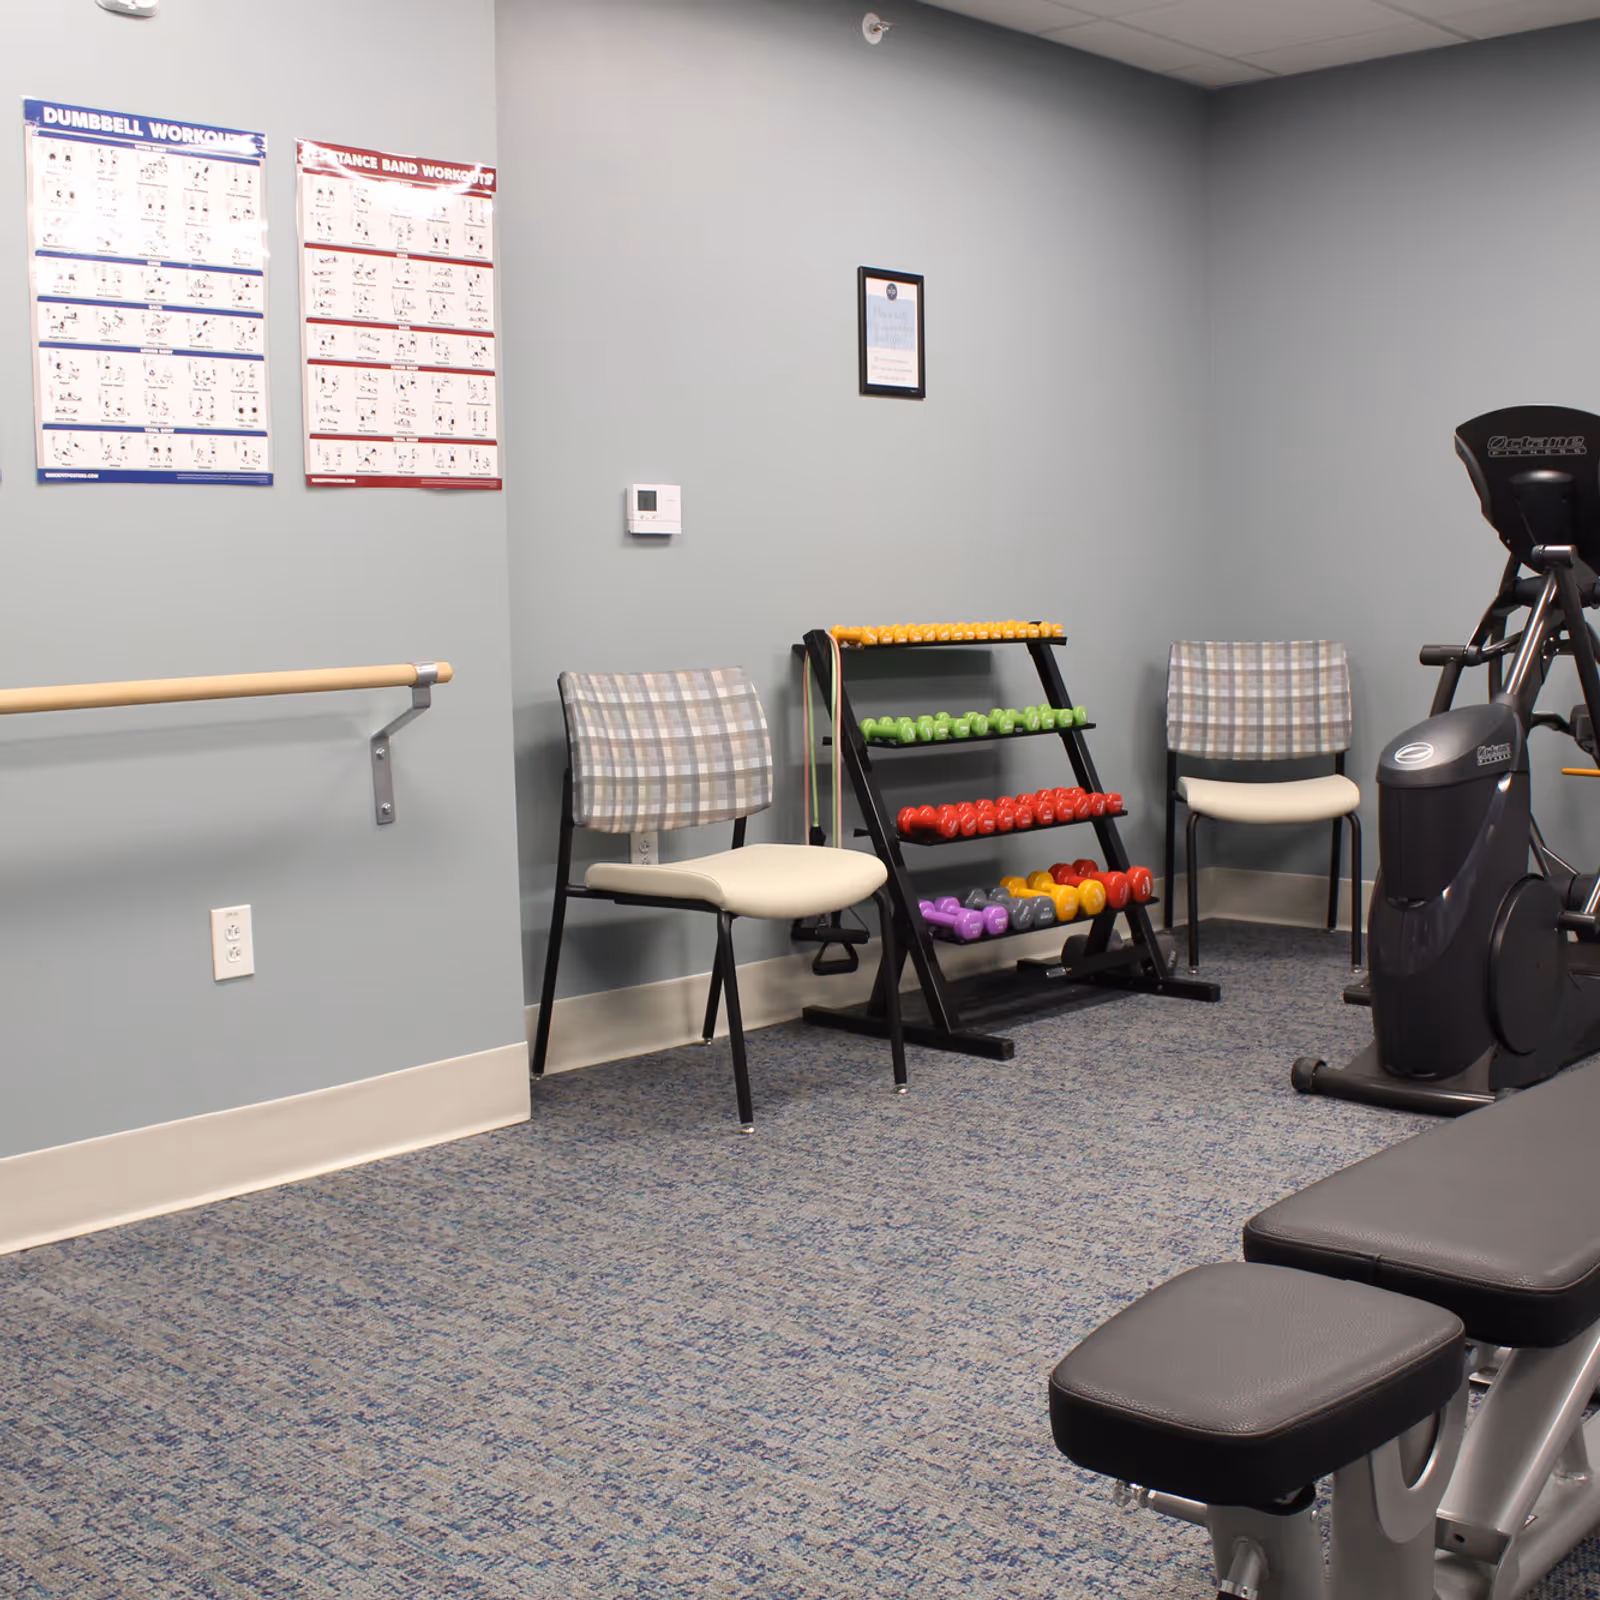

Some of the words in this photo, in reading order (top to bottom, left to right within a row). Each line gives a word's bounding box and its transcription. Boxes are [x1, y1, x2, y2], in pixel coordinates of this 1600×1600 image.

[43, 106, 143, 136] DUMBBELL
[382, 160, 418, 176] BAND
[422, 164, 494, 185] WORKOUTS
